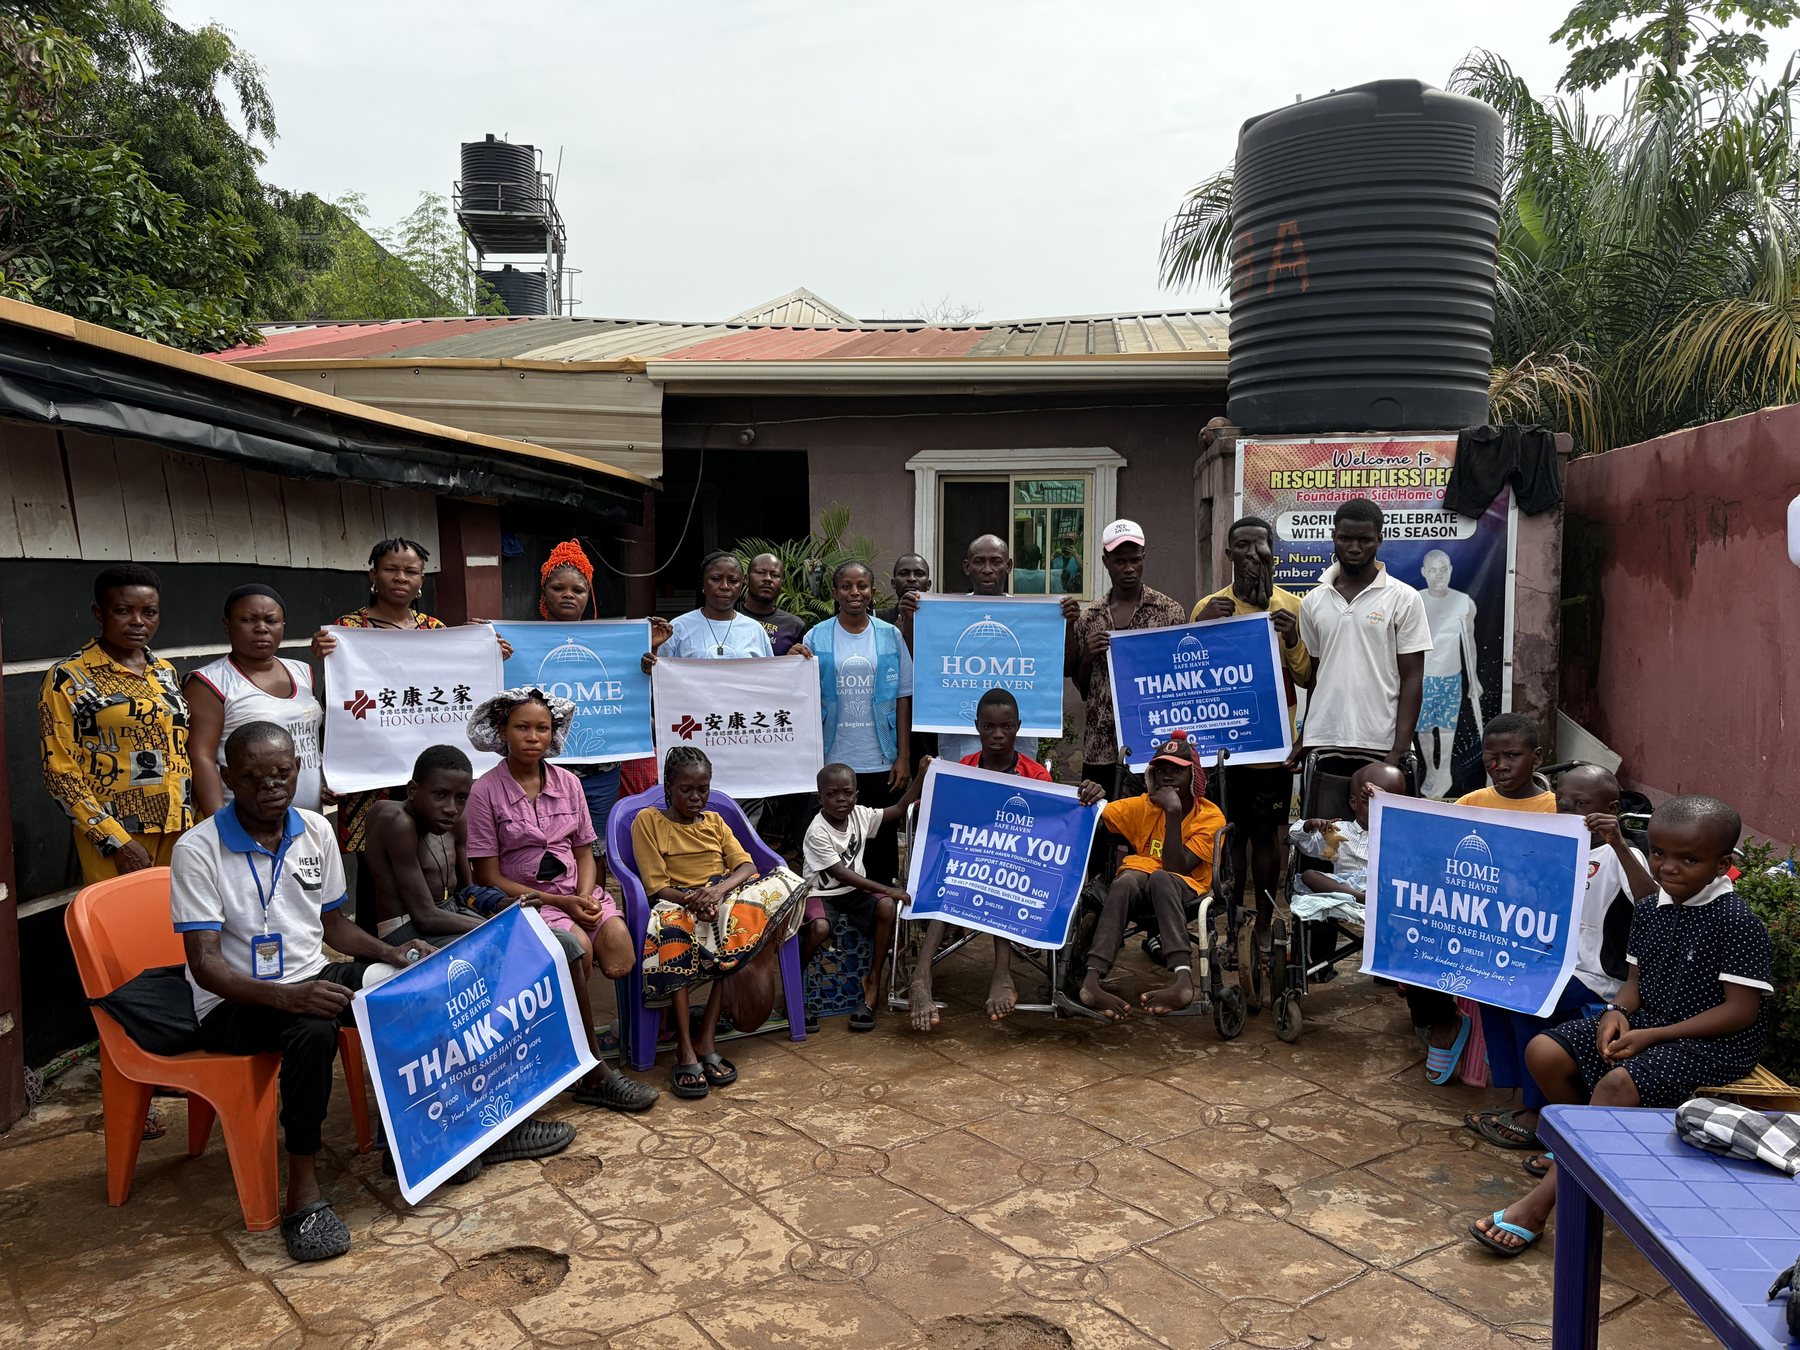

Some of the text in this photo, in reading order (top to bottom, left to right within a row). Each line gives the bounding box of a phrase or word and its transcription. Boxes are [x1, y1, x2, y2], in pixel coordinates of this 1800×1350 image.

[1333, 451, 1435, 468] Welcome to
[1270, 469, 1336, 489] RESCUE
[1339, 468, 1421, 488] HELPLESS
[1371, 489, 1395, 501] Sick
[1398, 489, 1432, 500] Home
[1292, 515, 1336, 526] SACRI
[1291, 528, 1325, 539] WITH
[1404, 527, 1458, 538] SEASON
[1289, 553, 1326, 563] Num.
[1273, 567, 1315, 578] umber
[762, 622, 778, 632] VER
[1172, 650, 1209, 663] HOME
[940, 656, 1036, 676] HOME
[942, 678, 1034, 690] SAFE HAVEN
[1134, 664, 1253, 695] THANK YOU
[378, 684, 473, 708] 安康之家
[380, 713, 425, 727] HONG
[704, 710, 792, 731] 安康之家
[287, 720, 317, 736] WHAT
[705, 732, 794, 746] HONG KONG
[995, 810, 1034, 828] HOME
[994, 822, 1032, 834] SAFE HAVEN
[950, 822, 1071, 865] THANK YOU
[975, 857, 1026, 872] SUPPORT RECEIVED
[1011, 854, 1040, 866] FOUNDATION
[314, 868, 321, 878] S
[1445, 858, 1500, 884] HOME
[968, 882, 987, 892] PROVIDE
[1002, 891, 1020, 901] SHELTER
[1445, 876, 1498, 894] SAFE HAVEN
[1032, 888, 1050, 899] NGN
[984, 901, 1004, 910] SHELTER
[1391, 878, 1558, 944] THANK YOU
[1030, 914, 1042, 922] HOPE
[1420, 936, 1435, 944] FOOD
[1431, 920, 1508, 946] HOME SAFE HAVEN
[1462, 946, 1484, 958] SHELTER
[1421, 951, 1434, 960] Your
[1435, 956, 1458, 968] kindness
[1459, 962, 1464, 970] is
[1466, 964, 1490, 978] changing
[1510, 960, 1526, 969] HOPE
[446, 977, 488, 1020] HOME
[452, 996, 492, 1030] SAFE HAVEN
[398, 975, 554, 1096] THANK YOU
[528, 1036, 542, 1049] HOPE
[449, 1032, 523, 1085] HOME SAFE HAVEN
[487, 1062, 506, 1080] SHELTER
[445, 1094, 459, 1108] FOOD
[450, 1110, 464, 1124] Your
[466, 1092, 488, 1113] kindness
[488, 1088, 494, 1096] is
[494, 1071, 519, 1091] changing
